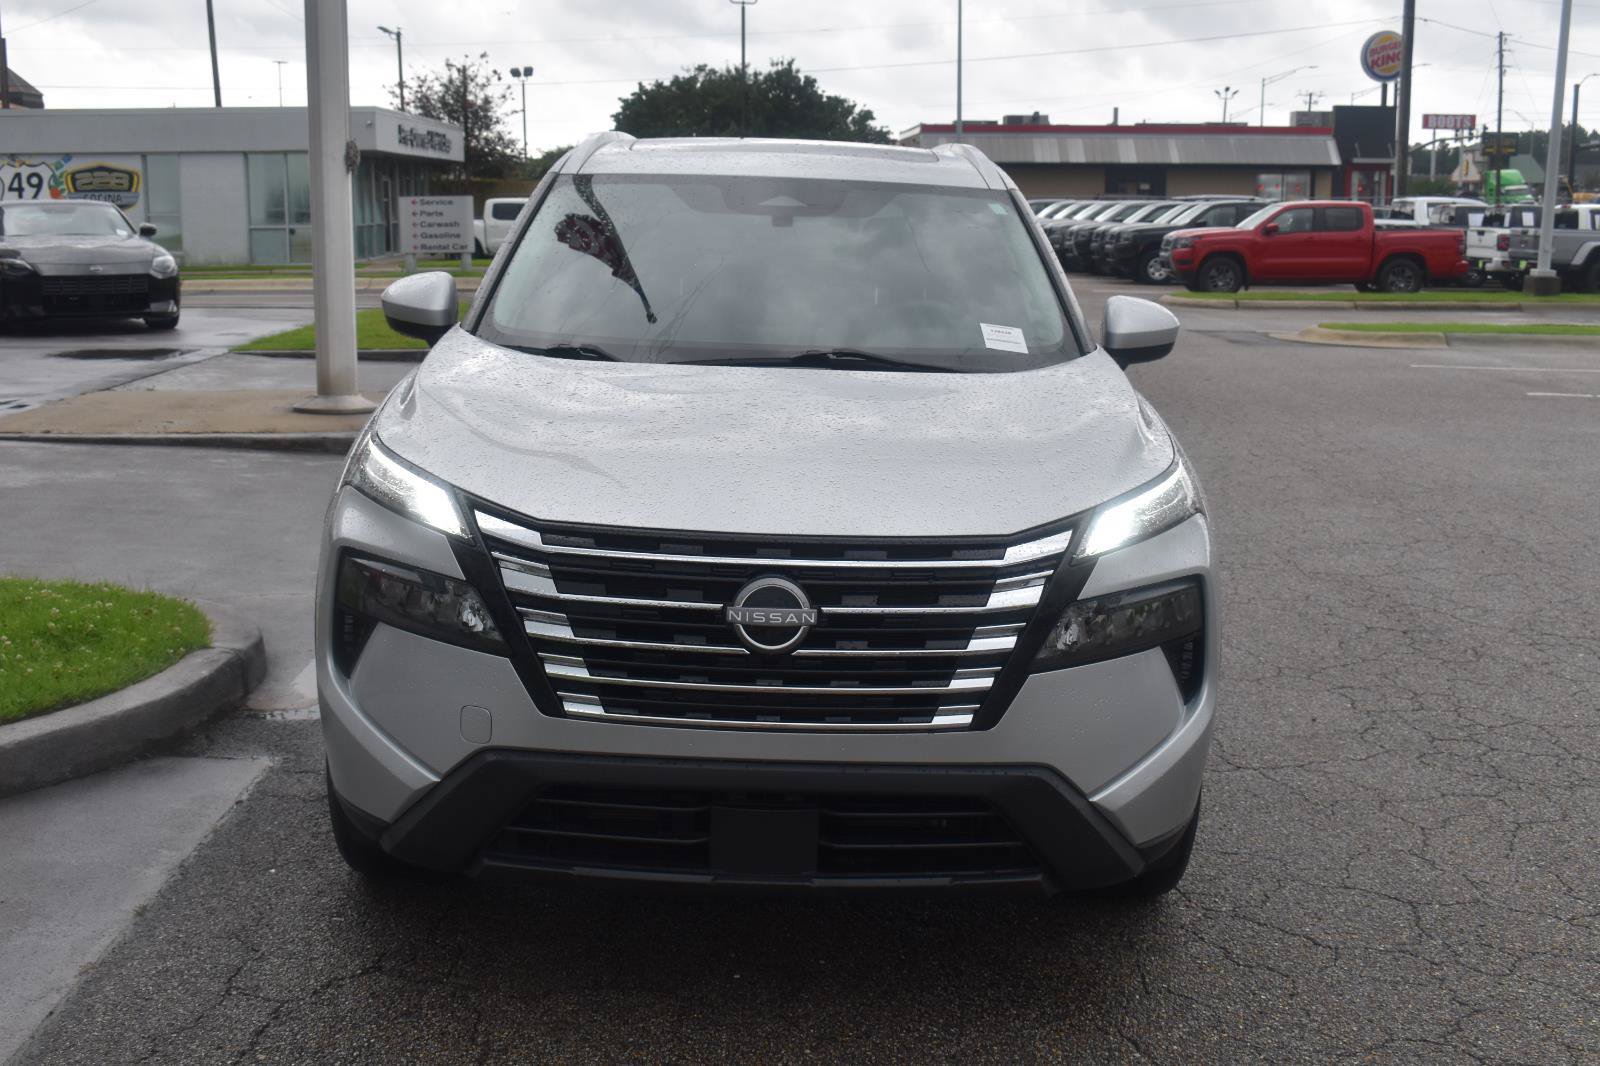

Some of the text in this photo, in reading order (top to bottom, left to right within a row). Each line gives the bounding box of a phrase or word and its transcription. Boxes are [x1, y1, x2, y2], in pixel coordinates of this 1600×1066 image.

[1428, 115, 1472, 129] BOOTS
[8, 172, 43, 199] 49
[728, 610, 815, 624] NISSAN
